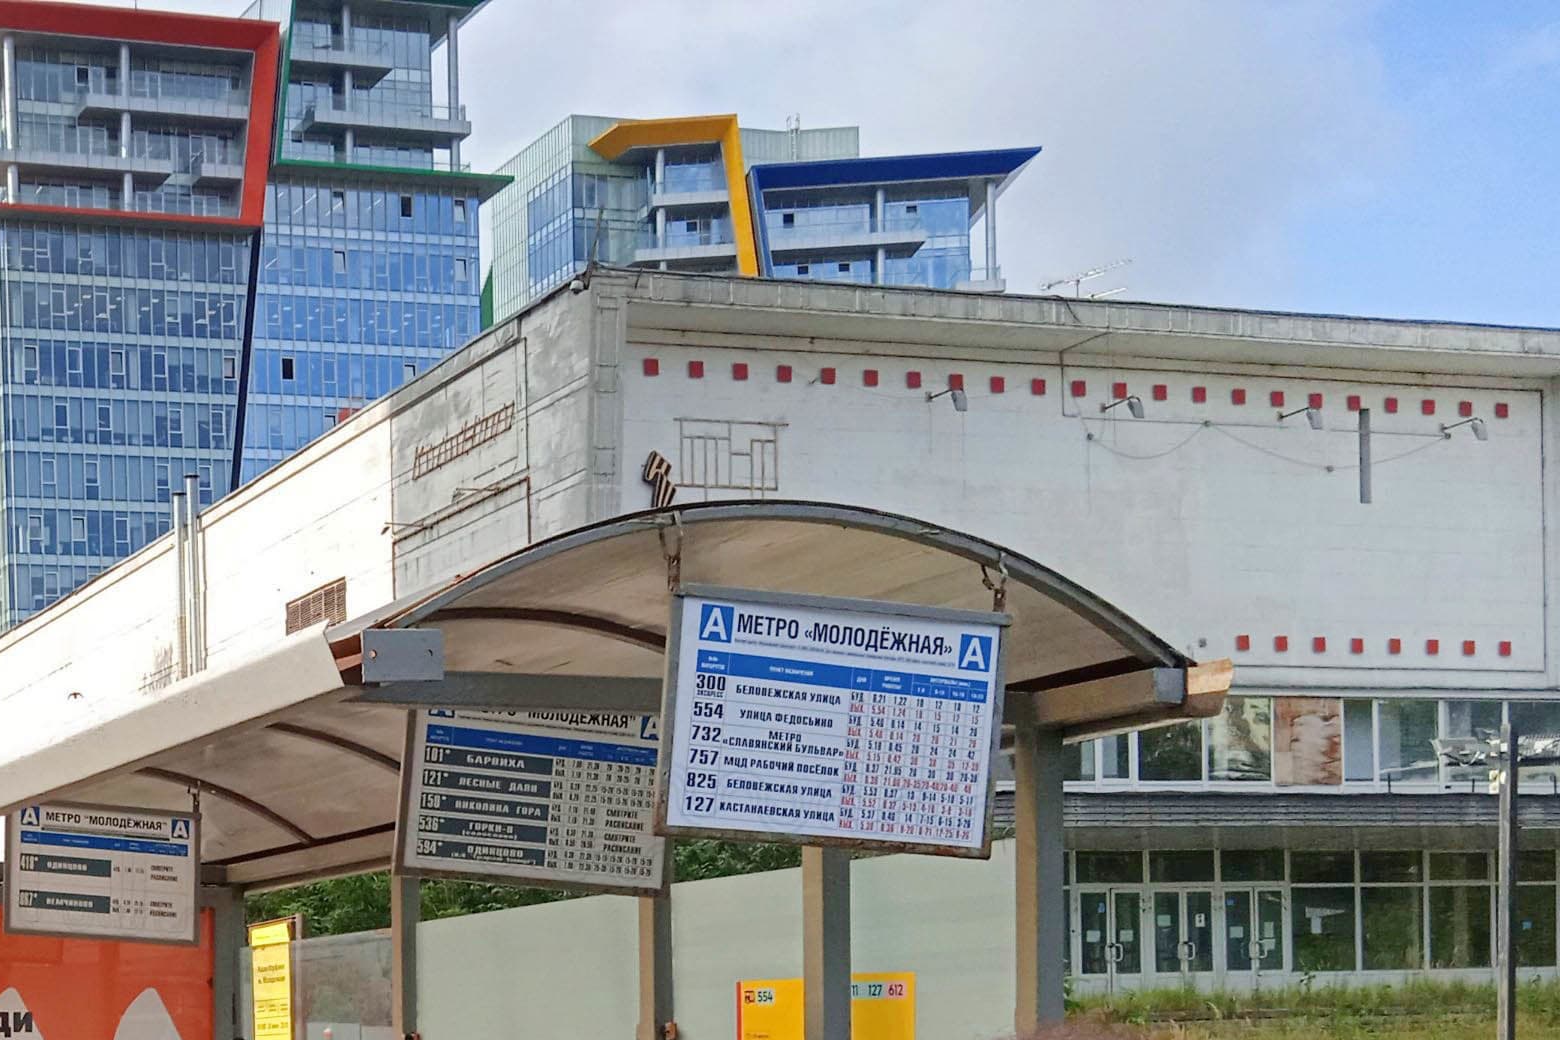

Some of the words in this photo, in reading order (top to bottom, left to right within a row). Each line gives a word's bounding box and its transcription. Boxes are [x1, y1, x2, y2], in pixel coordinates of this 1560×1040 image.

[701, 607, 728, 640] А
[737, 613, 799, 640] МЕТРО
[804, 622, 953, 656] «МОЛОДЁЖНАЯ»
[960, 637, 985, 670] А
[696, 674, 726, 691] 300
[736, 684, 808, 701] БЕЛОВЕЖСКАЯ
[809, 693, 841, 706] УЛИЦА
[693, 701, 724, 719] 554
[740, 709, 772, 723] УЛИЦА
[775, 712, 833, 728] ФЕДОСЬИНО
[692, 725, 721, 743] 732
[769, 731, 802, 743] МЕТРО
[722, 737, 793, 752] «СЛАВЯНСКИЙ
[466, 754, 525, 769] БАРВИХА
[690, 748, 719, 766] 757
[724, 756, 748, 769] МЦД
[750, 759, 794, 772] РАБОЧИЙ
[458, 777, 501, 790] ЛЕСНЫЕ
[687, 772, 717, 789] 825
[726, 779, 798, 794] БЕЛОВЕЖСКАЯ
[801, 785, 832, 799] УЛИЦА
[516, 806, 542, 817] ГОРА
[685, 796, 715, 813] 127
[719, 801, 801, 818] КАСТАНАЕВСКАЯ
[803, 810, 835, 822] УЛИЦА
[23, 808, 38, 825] А
[46, 811, 81, 824] МЕТРО
[173, 820, 189, 838] А
[757, 991, 774, 1003] 554
[868, 984, 882, 996] 127
[888, 984, 903, 996] 612
